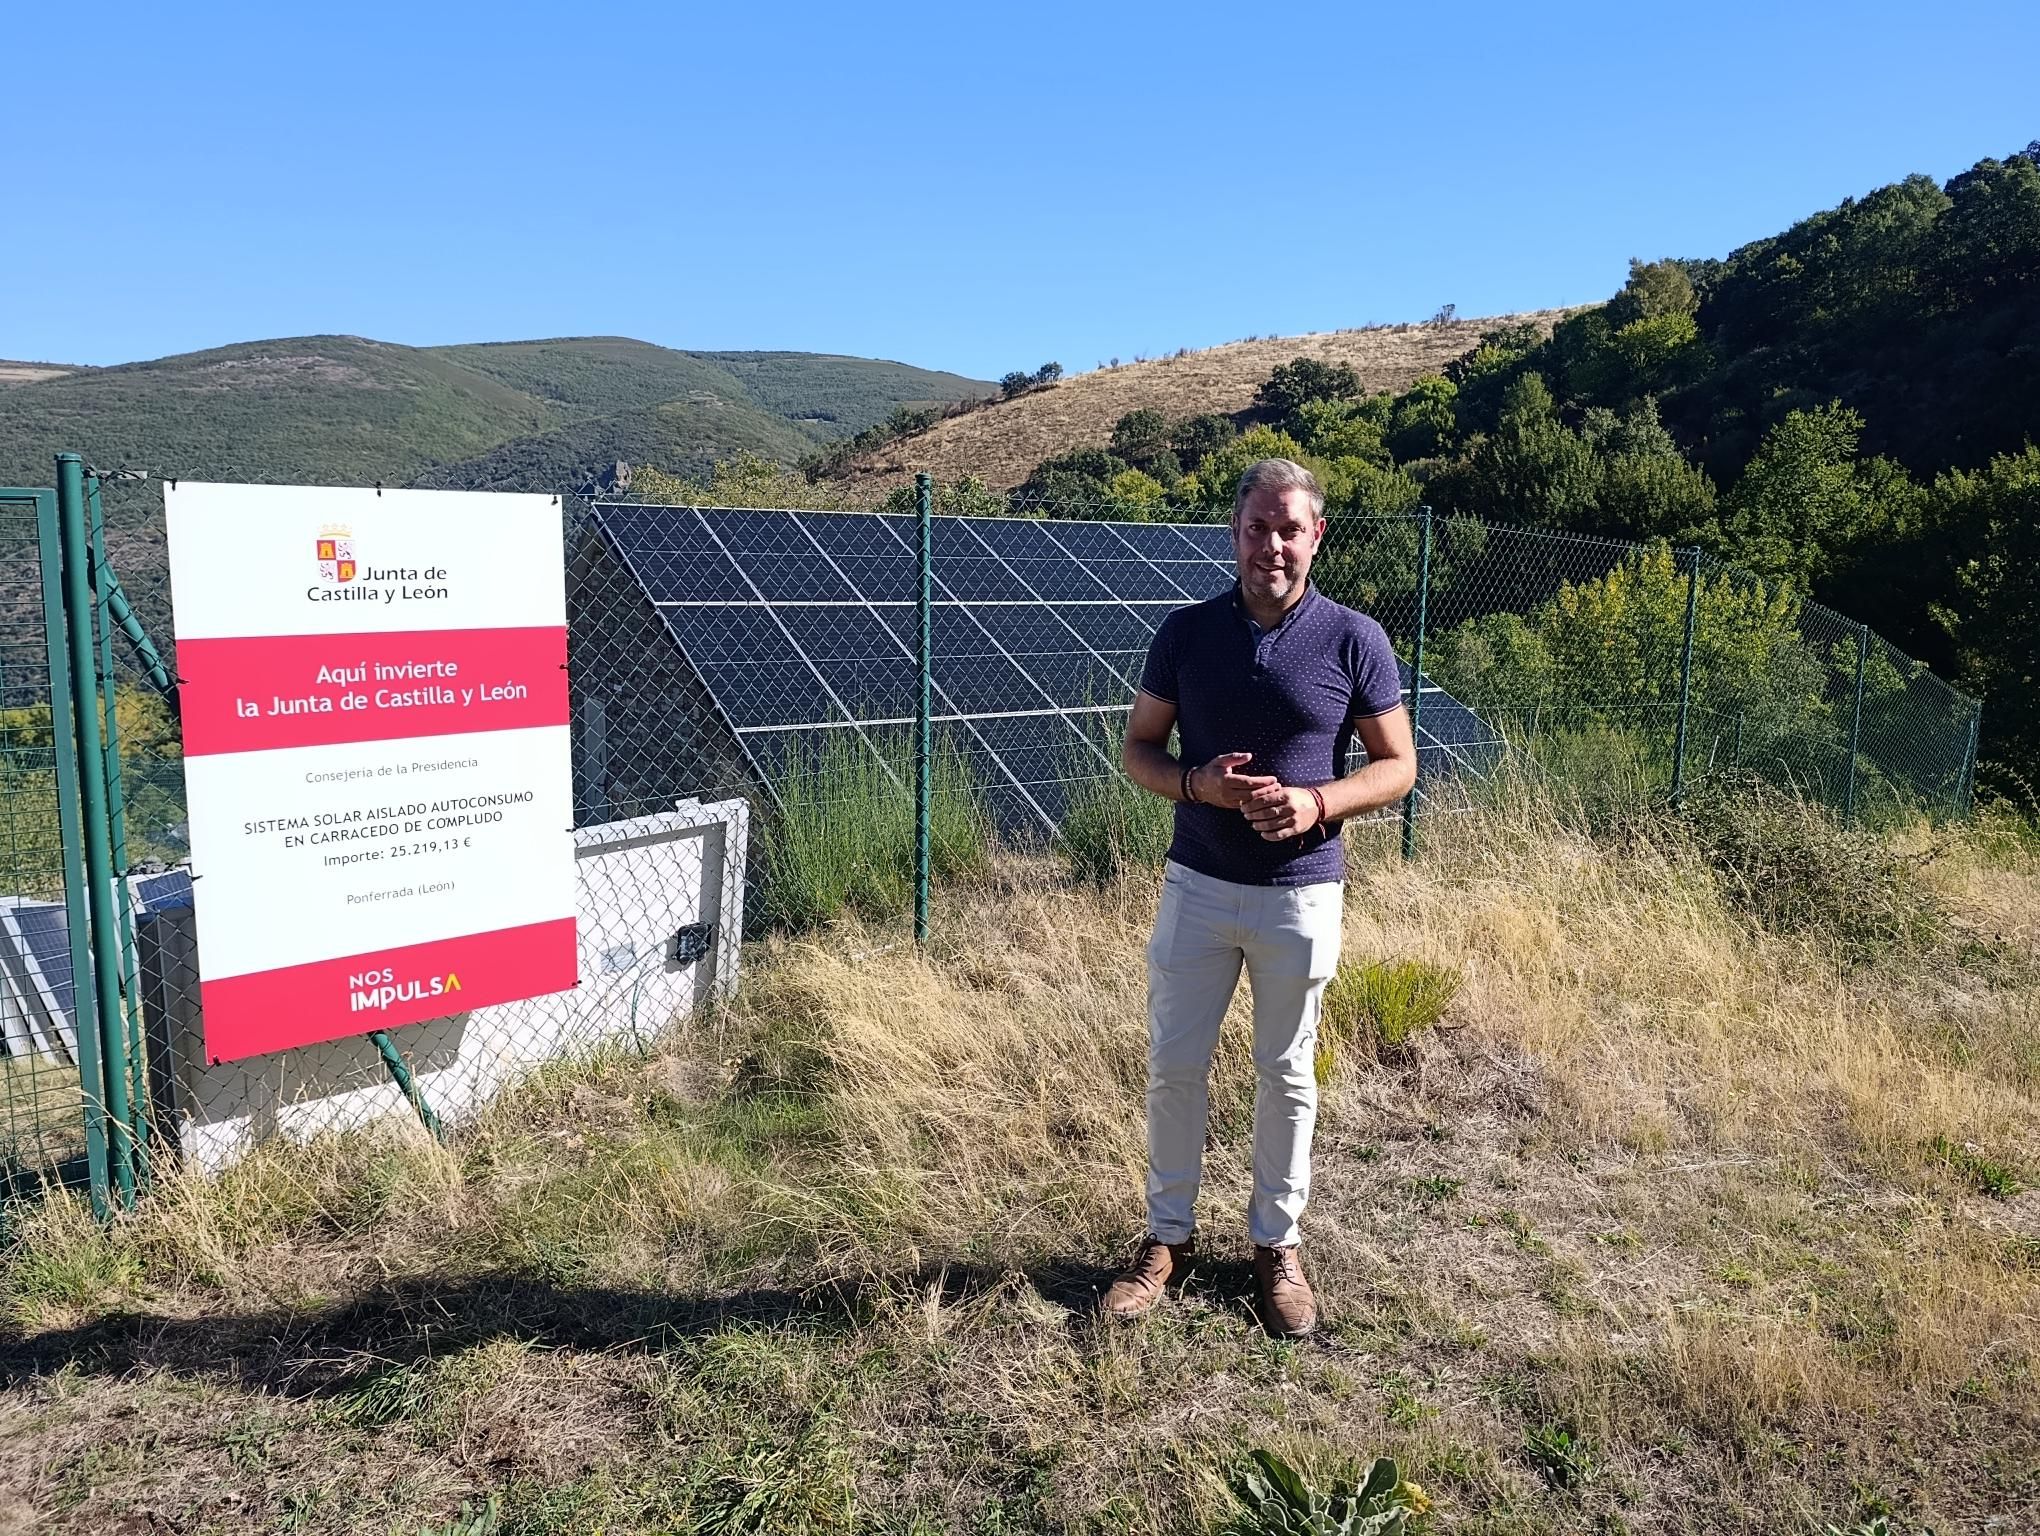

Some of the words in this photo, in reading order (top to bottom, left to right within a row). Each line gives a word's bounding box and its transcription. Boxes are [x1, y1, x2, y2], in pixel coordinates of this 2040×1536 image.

[363, 567, 417, 580] Junta
[424, 567, 446, 580] de
[307, 586, 379, 602] Castilla
[385, 589, 395, 604] y
[403, 585, 447, 599] León
[317, 662, 366, 687] Aquí
[374, 661, 457, 680] invierte
[237, 699, 259, 717] la
[268, 696, 332, 715] Junta
[340, 691, 368, 710] de
[375, 686, 455, 708] Castilla
[462, 689, 473, 706] y
[481, 681, 526, 701] León
[378, 766, 392, 776] de
[397, 764, 407, 774] la
[412, 757, 478, 773] Presidencia
[245, 818, 310, 835] SISTEMA
[314, 811, 362, 826] SOLAR
[366, 804, 426, 821] AISLADO
[431, 792, 534, 814] AUTOCONSUMO
[284, 835, 305, 848] EN
[309, 824, 400, 845] CARRACEDO
[404, 820, 423, 833] DE
[427, 811, 503, 829] COMPLUDO
[325, 851, 384, 866] Importe:
[391, 839, 458, 857] 25.219,13
[463, 837, 472, 848] €
[347, 887, 413, 904] Ponferrada
[419, 881, 454, 895] (León)
[350, 968, 394, 987] NOS
